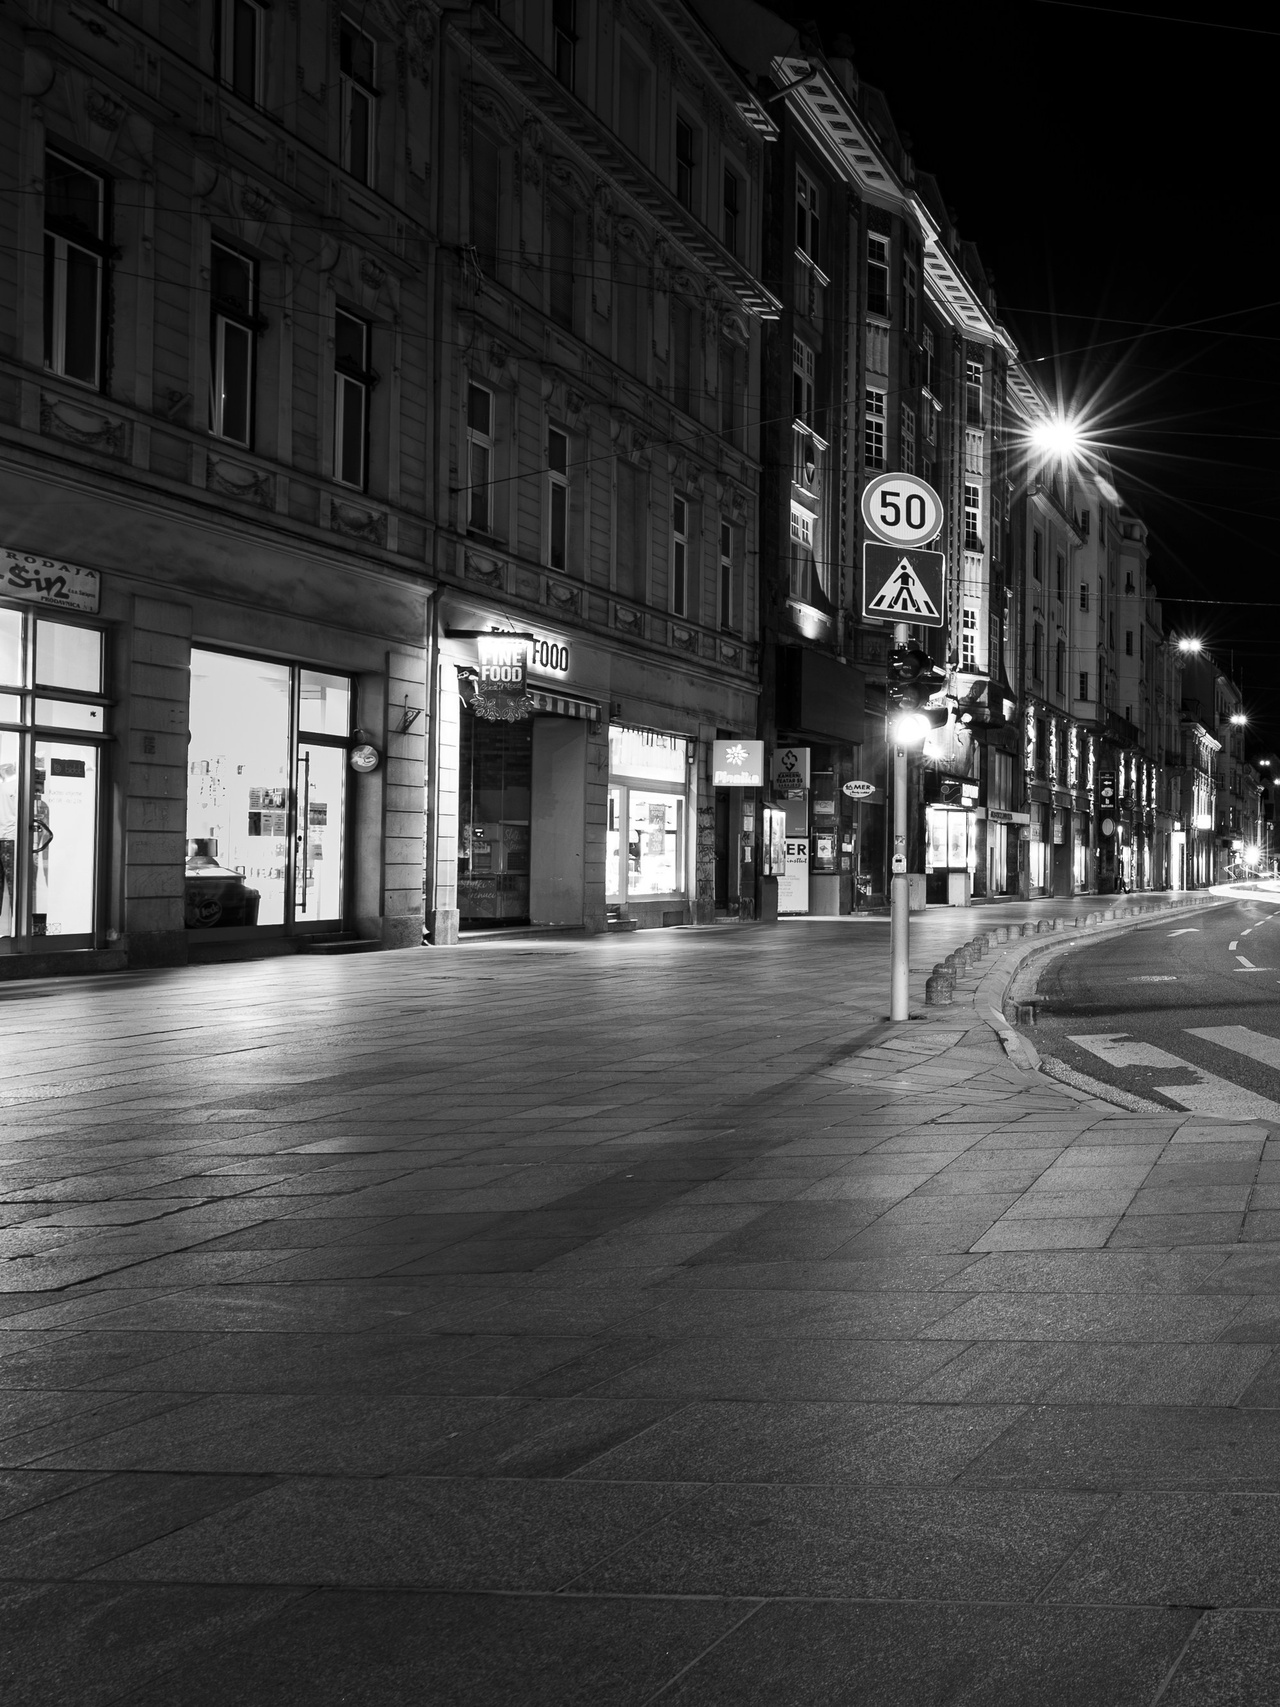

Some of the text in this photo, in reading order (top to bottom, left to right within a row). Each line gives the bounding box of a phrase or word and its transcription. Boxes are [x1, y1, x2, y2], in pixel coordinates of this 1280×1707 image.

[880, 490, 926, 530] 50
[5, 551, 97, 579] RODAJA
[481, 645, 523, 666] FINE
[532, 638, 570, 672] FOOD
[481, 665, 523, 682] FOOD
[786, 843, 807, 856] ER
